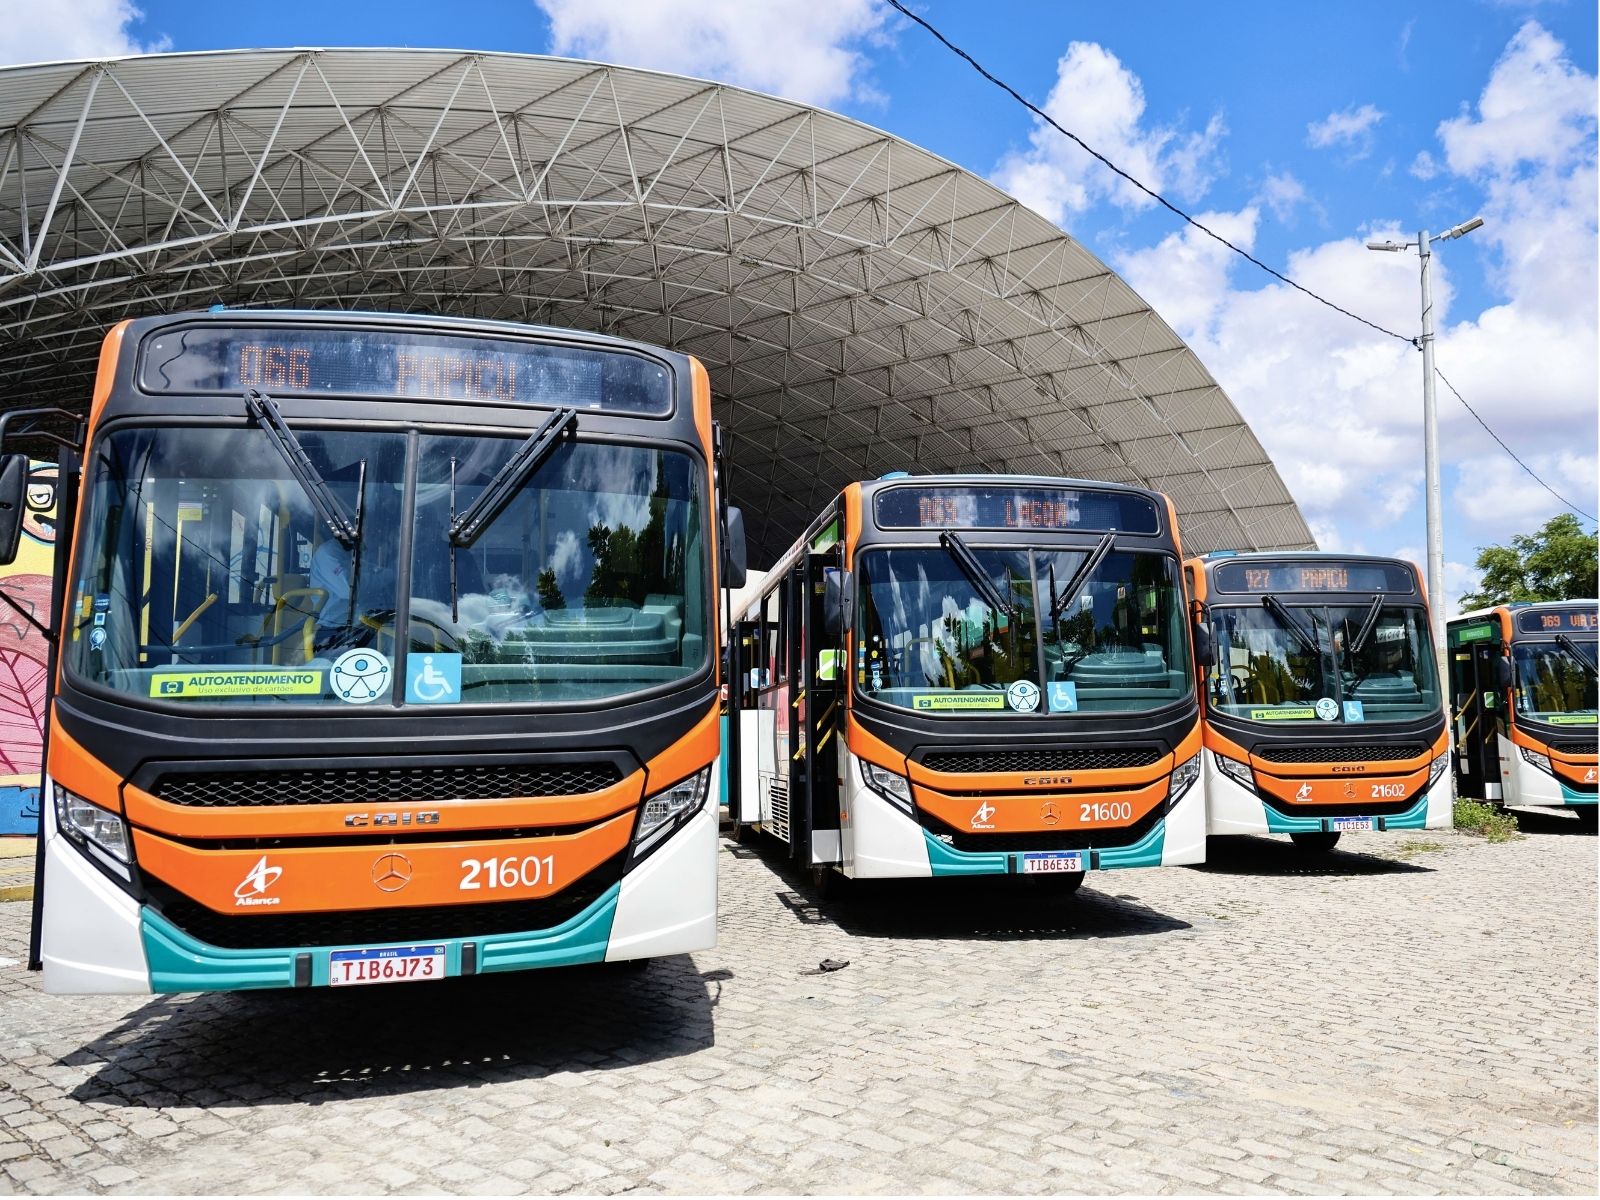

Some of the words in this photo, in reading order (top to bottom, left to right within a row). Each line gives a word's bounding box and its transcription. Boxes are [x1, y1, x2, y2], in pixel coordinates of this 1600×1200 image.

[241, 345, 310, 388] 066
[399, 354, 516, 400] PAPICU
[1302, 568, 1348, 588] PAPICU
[189, 675, 314, 686] AUTOATENDIMENTO
[934, 696, 1000, 704] AUTOATENDIMENTO
[1371, 784, 1405, 798] 21602
[1080, 801, 1132, 822] 21600
[459, 855, 554, 890] 21601
[1030, 858, 1076, 871] TIB6E33
[342, 957, 434, 981] TIB6J73
